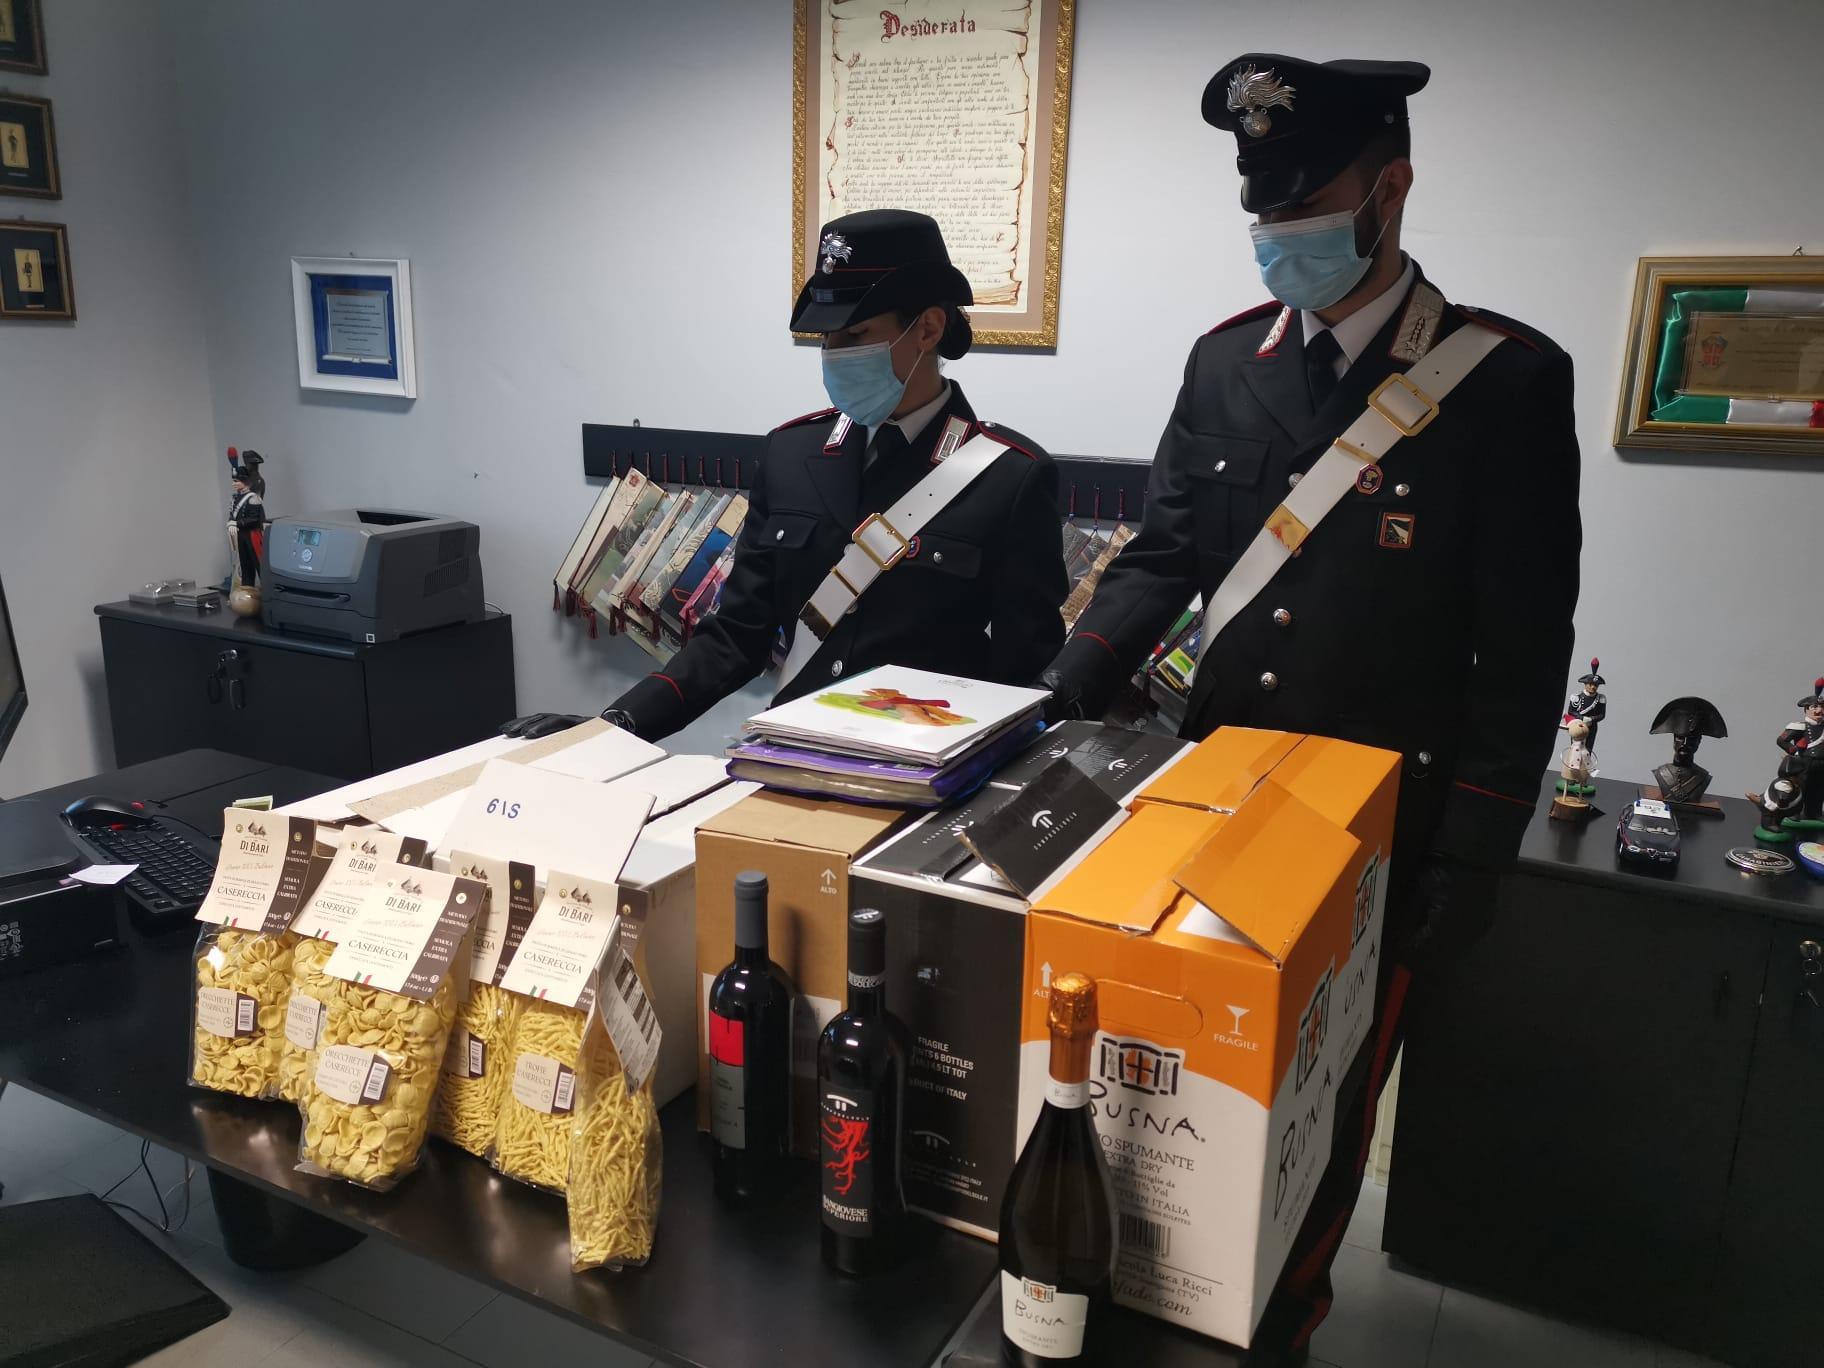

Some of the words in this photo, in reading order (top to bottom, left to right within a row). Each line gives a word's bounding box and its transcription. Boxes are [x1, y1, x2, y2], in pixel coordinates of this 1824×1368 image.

[880, 9, 976, 43] Desiderata
[240, 840, 249, 850] DI
[250, 841, 270, 854] BARI
[348, 858, 358, 868] DI
[358, 859, 377, 873] BARI
[217, 885, 266, 901] CASERECCIA
[820, 886, 838, 895] ALTO
[385, 896, 397, 908] DI
[397, 898, 422, 913] BARI
[558, 905, 570, 917] DI
[570, 908, 593, 923] BARI
[348, 939, 408, 961] CASERECCIA
[523, 951, 582, 974] CASERECCIA
[917, 1036, 950, 1052] FRAGILE
[1213, 1033, 1259, 1051] FRAGILE
[934, 1051, 940, 1060] 6
[940, 1054, 974, 1070] BOTTLES
[951, 1067, 968, 1079] TOT
[946, 1088, 968, 1101] ITALY
[1114, 1139, 1195, 1172] SPUMANTE
[1140, 1160, 1163, 1174] DRY
[1152, 1185, 1169, 1198] Vol
[1166, 1179, 1176, 1189] da
[1152, 1196, 1190, 1217] ITALIA
[1151, 1266, 1178, 1285] Luca
[1183, 1277, 1213, 1296] Ricci
